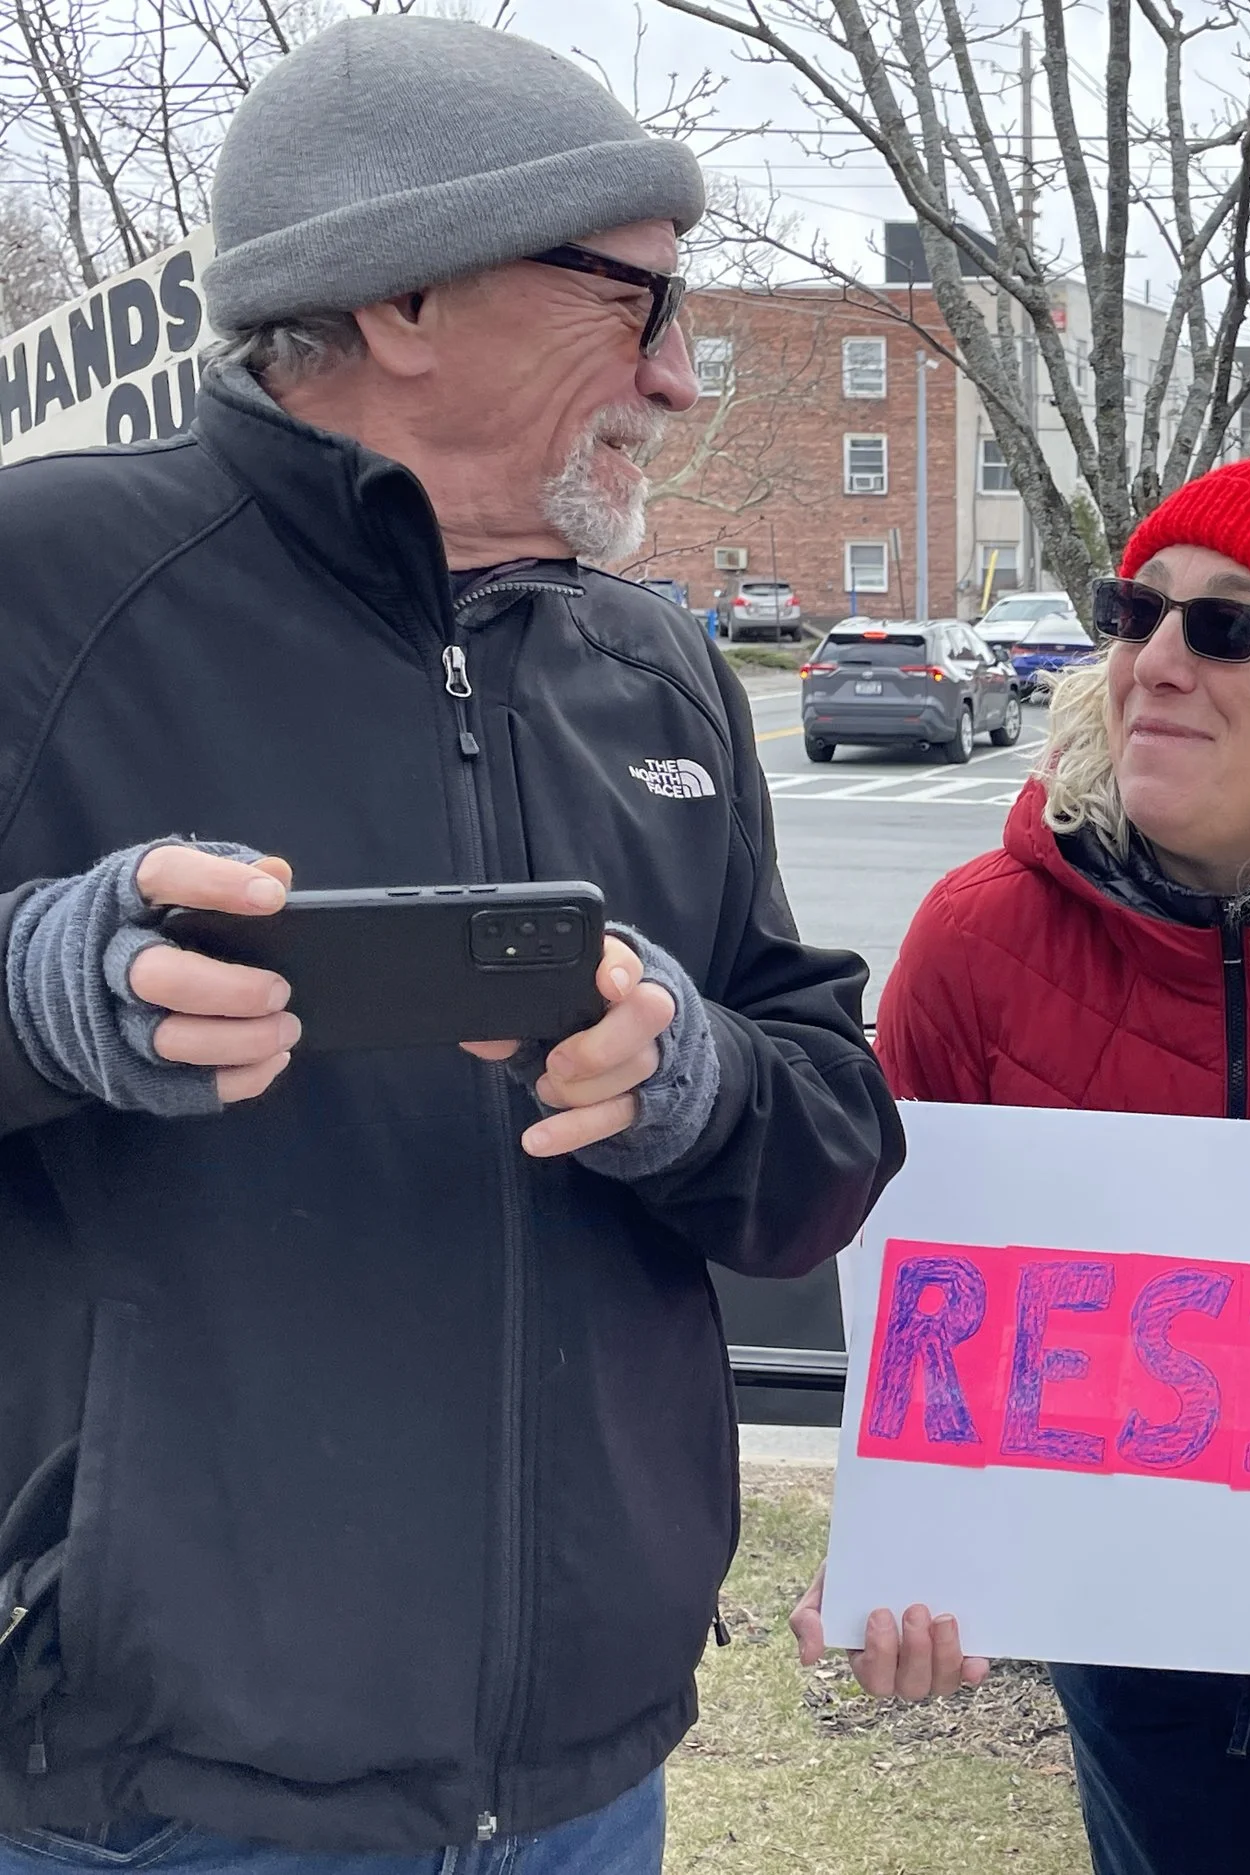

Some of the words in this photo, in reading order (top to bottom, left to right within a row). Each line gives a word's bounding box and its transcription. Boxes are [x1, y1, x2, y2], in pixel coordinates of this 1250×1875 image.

[0, 250, 203, 445] HANDS
[106, 357, 205, 445] OU
[628, 765, 681, 785] NORTH
[644, 759, 678, 773] THE
[646, 781, 684, 798] FACE
